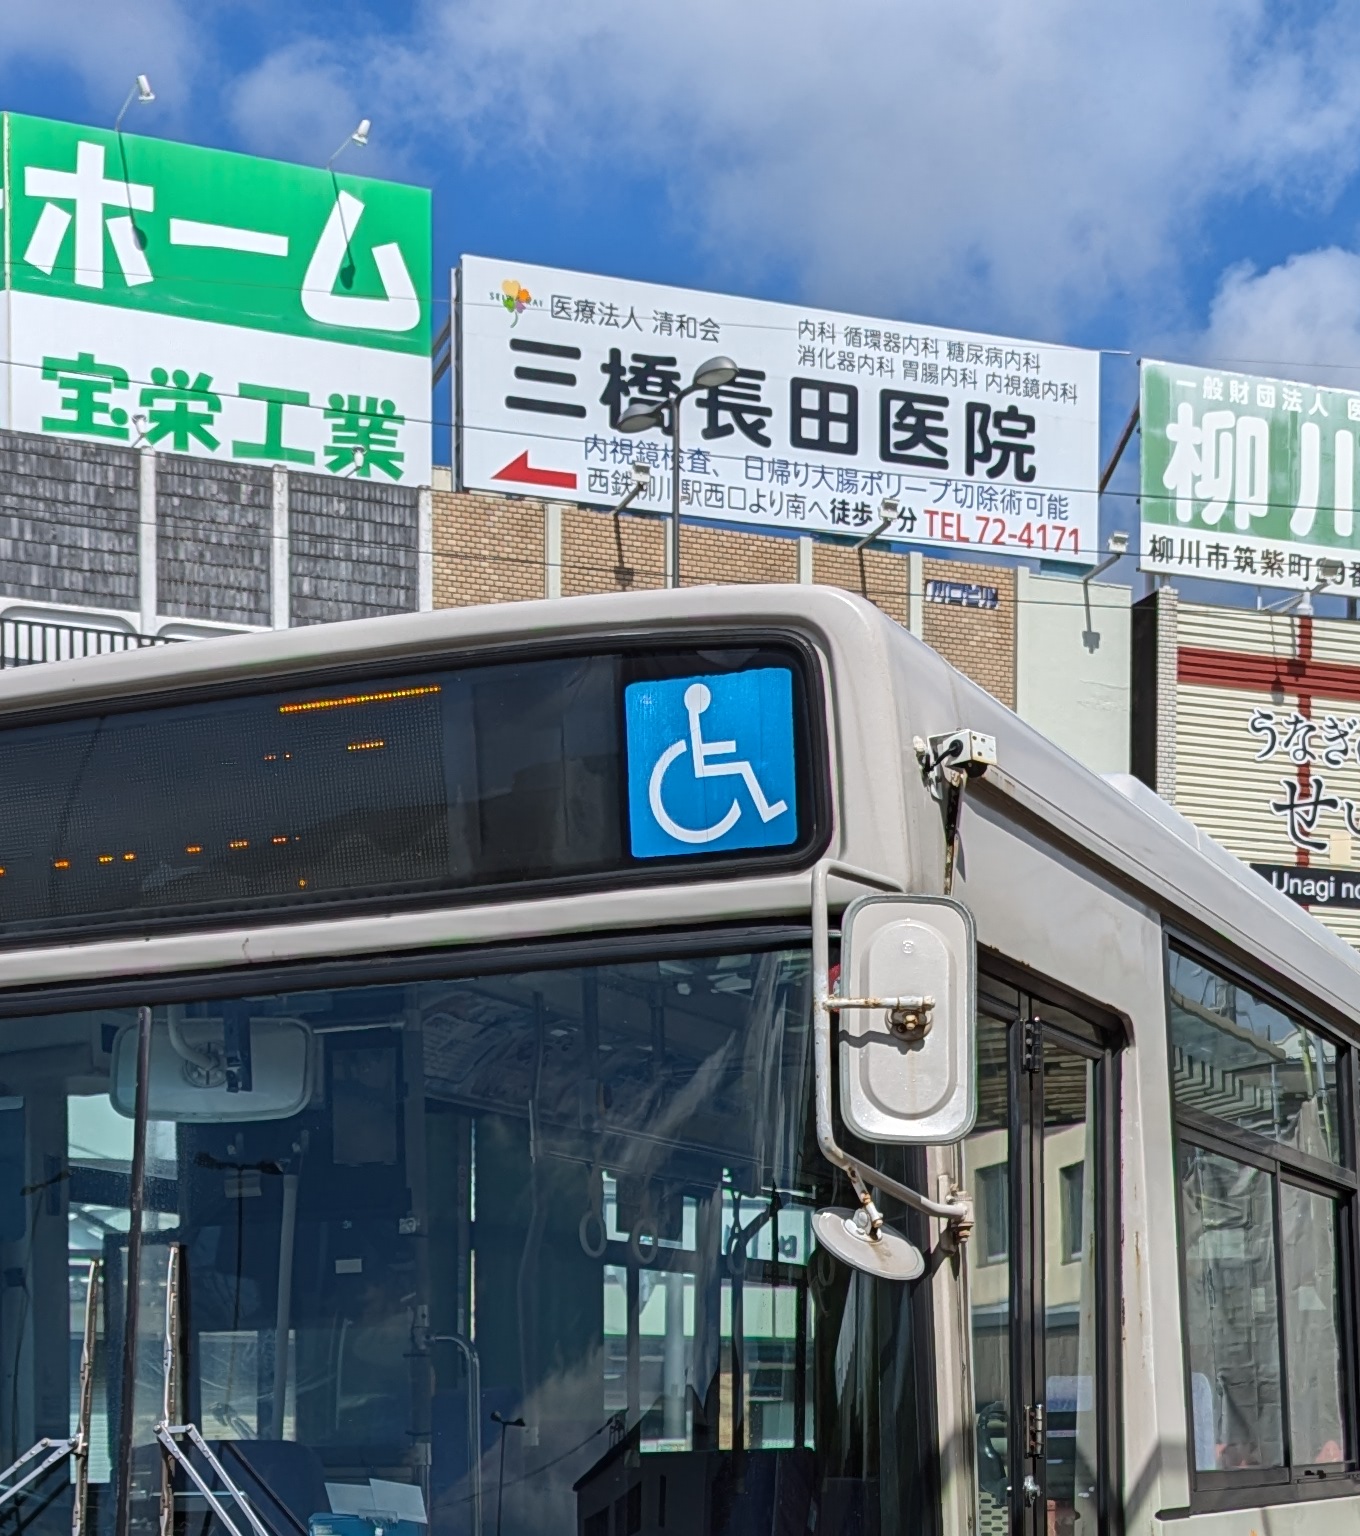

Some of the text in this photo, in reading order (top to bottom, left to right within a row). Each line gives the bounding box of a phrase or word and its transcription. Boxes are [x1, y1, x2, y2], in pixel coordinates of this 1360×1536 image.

[23, 141, 422, 332] ホーム
[551, 294, 721, 343] 医療法人 清和会
[797, 319, 1041, 375] 内科 循環器内科 糖尿病内科
[797, 344, 1078, 405] 消化器内科 胃腸内科 内視鏡内科
[41, 352, 407, 482] 宝栄工業
[503, 337, 1037, 483] 三橋長田医院
[1176, 375, 1330, 418] 一般財団法人
[924, 509, 970, 544] TEL
[975, 516, 1081, 555] 72-4171
[1272, 871, 1335, 902] Unagi
